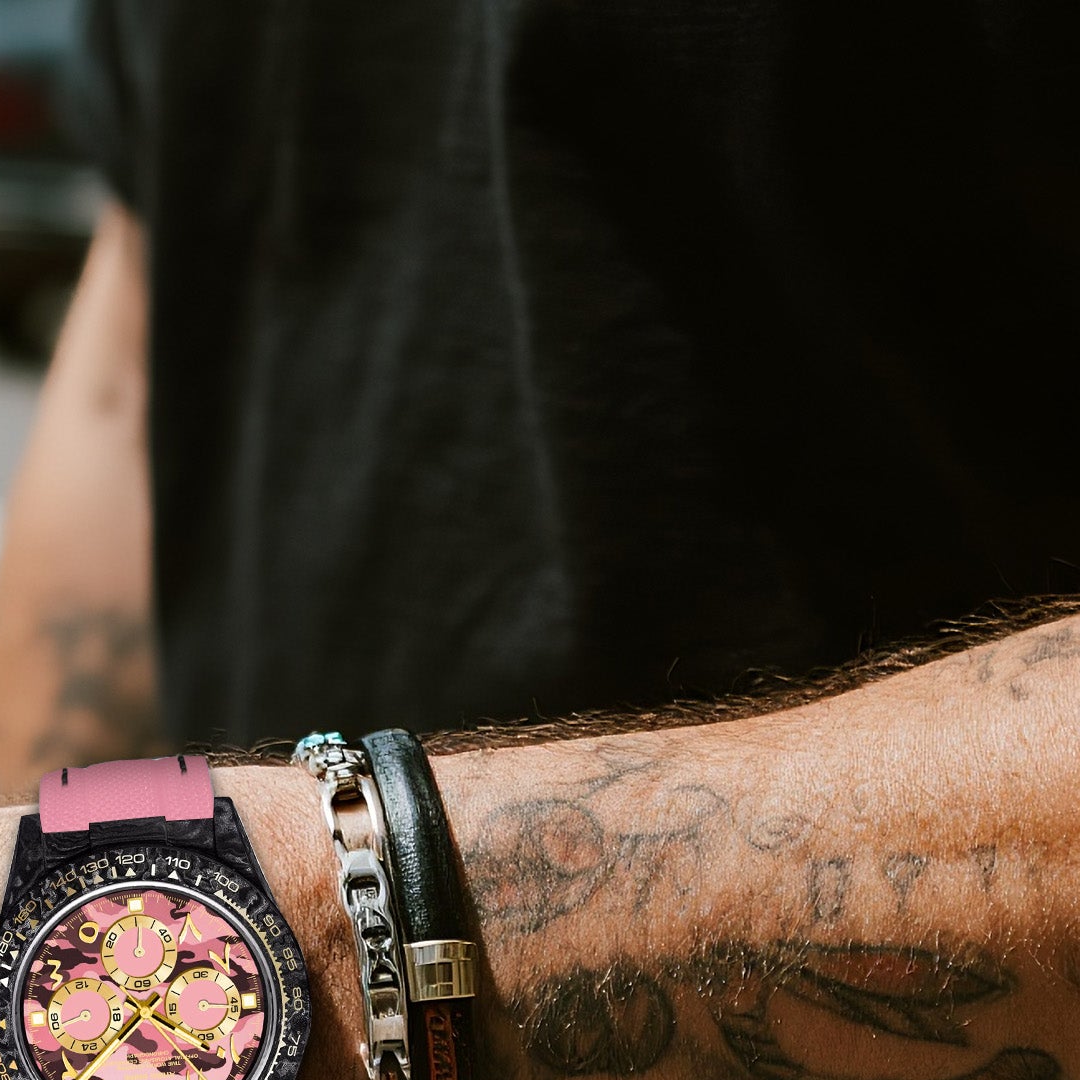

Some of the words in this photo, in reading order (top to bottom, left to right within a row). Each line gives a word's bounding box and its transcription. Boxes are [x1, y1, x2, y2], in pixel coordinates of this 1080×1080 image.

[80, 858, 109, 874] 130
[115, 854, 145, 865] 120
[165, 856, 191, 870] 110
[49, 870, 77, 890] 140
[213, 872, 239, 893] 100
[263, 914, 281, 937] 90
[105, 932, 117, 949] 20
[158, 928, 172, 943] 40
[282, 947, 298, 971] 85
[192, 971, 209, 979] 30
[75, 981, 89, 990] 12
[134, 979, 151, 988] 60
[230, 997, 239, 1013] 45
[292, 986, 303, 1011] 80
[112, 1007, 121, 1022] 18
[168, 1002, 177, 1016] 15
[197, 1032, 215, 1041] 60
[81, 1042, 98, 1051] 24
[288, 1034, 301, 1057] 75
